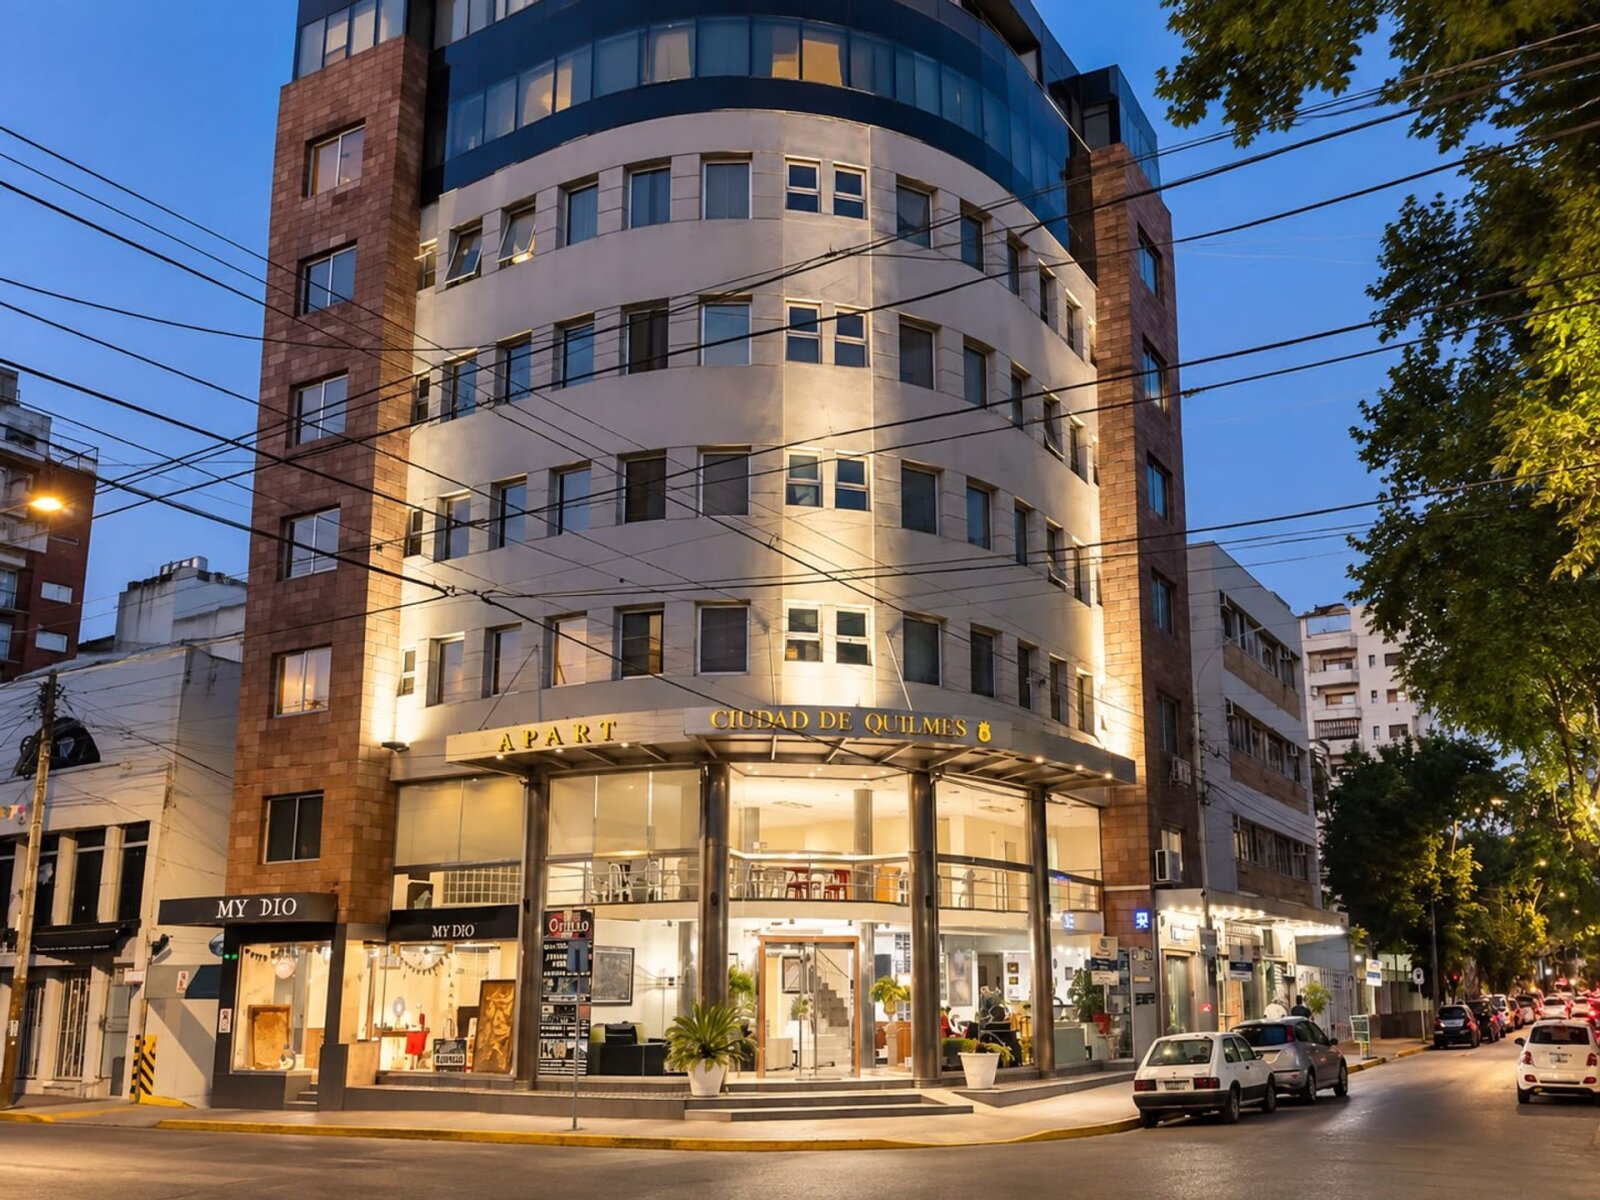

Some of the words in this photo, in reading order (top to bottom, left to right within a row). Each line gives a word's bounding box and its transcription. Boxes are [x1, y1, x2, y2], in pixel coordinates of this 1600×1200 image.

[710, 709, 809, 730] CIUDAD
[819, 711, 854, 731] DE
[864, 712, 967, 736] QUILMES
[498, 720, 617, 752] APART
[215, 899, 250, 919] MY
[259, 897, 298, 917] DIO
[431, 924, 451, 938] MY
[452, 924, 475, 938] DIO
